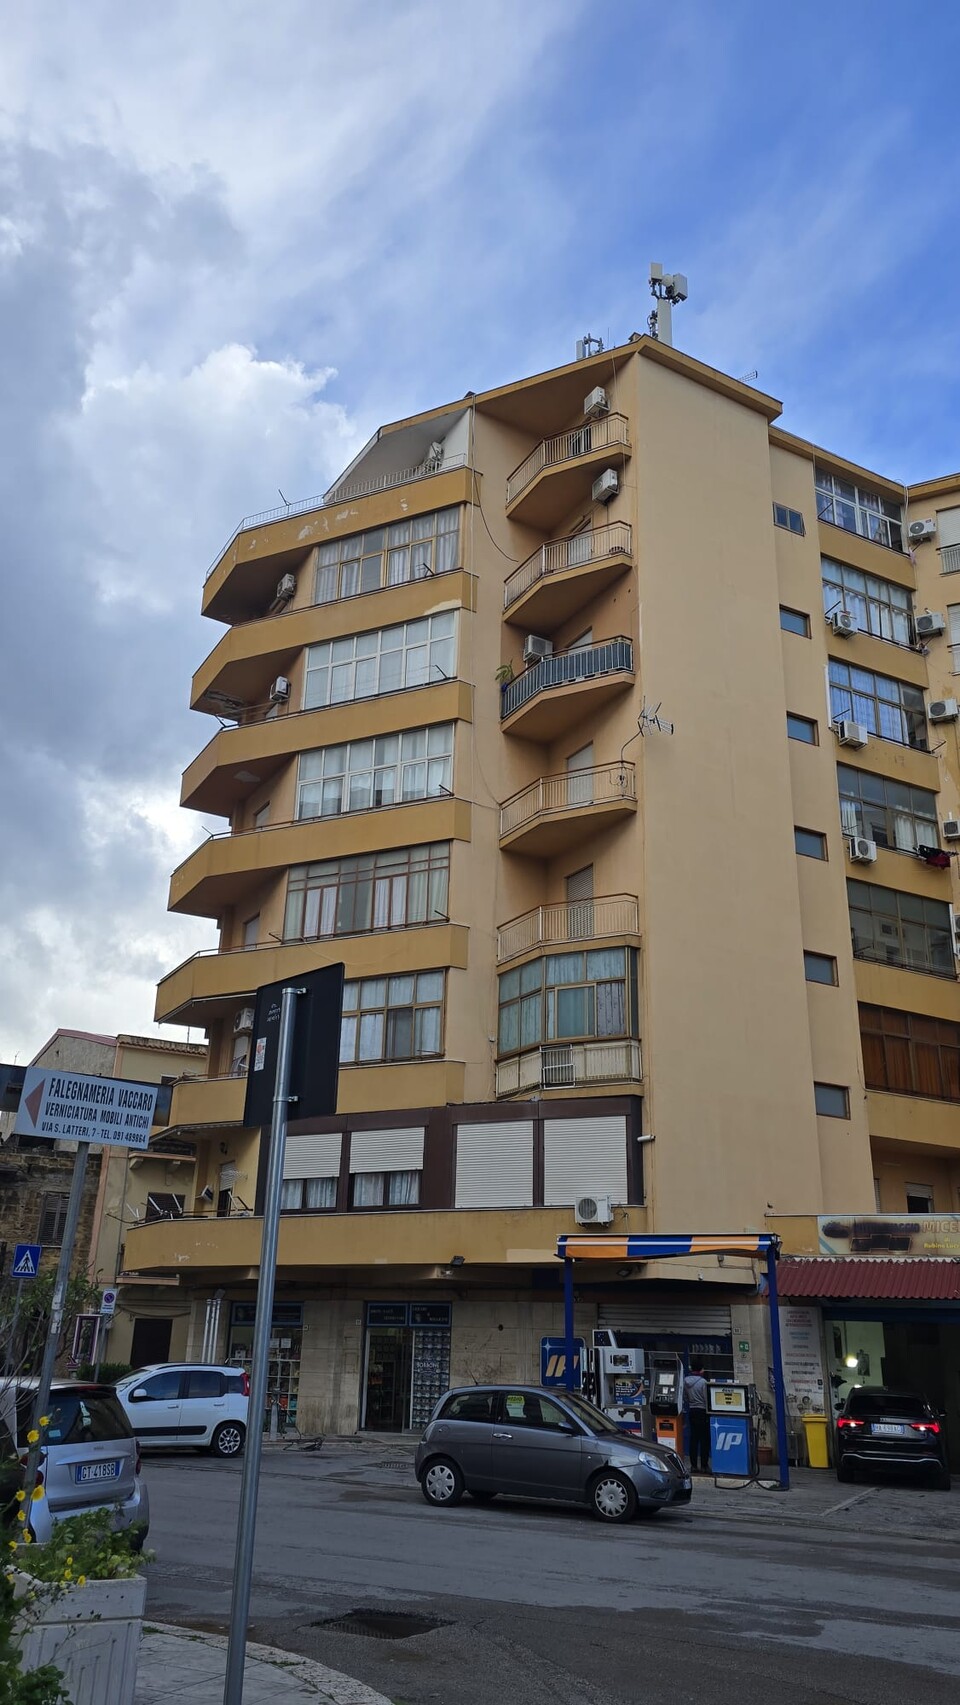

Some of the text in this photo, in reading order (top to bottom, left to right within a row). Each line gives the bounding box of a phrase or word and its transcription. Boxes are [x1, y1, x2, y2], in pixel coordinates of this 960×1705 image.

[48, 1078, 153, 1112] FALEGNAMERIA VACCARO
[45, 1102, 149, 1129] VERNICIATURA MOBILI ANTICHI
[41, 1121, 53, 1132] VIA
[54, 1123, 61, 1133] S.
[91, 1127, 96, 1137] 7
[100, 1129, 112, 1139] TEL.
[112, 1131, 124, 1141] 091
[923, 1221, 960, 1233] MICE
[715, 1432, 743, 1451] IP
[93, 1463, 115, 1477] 418SB
